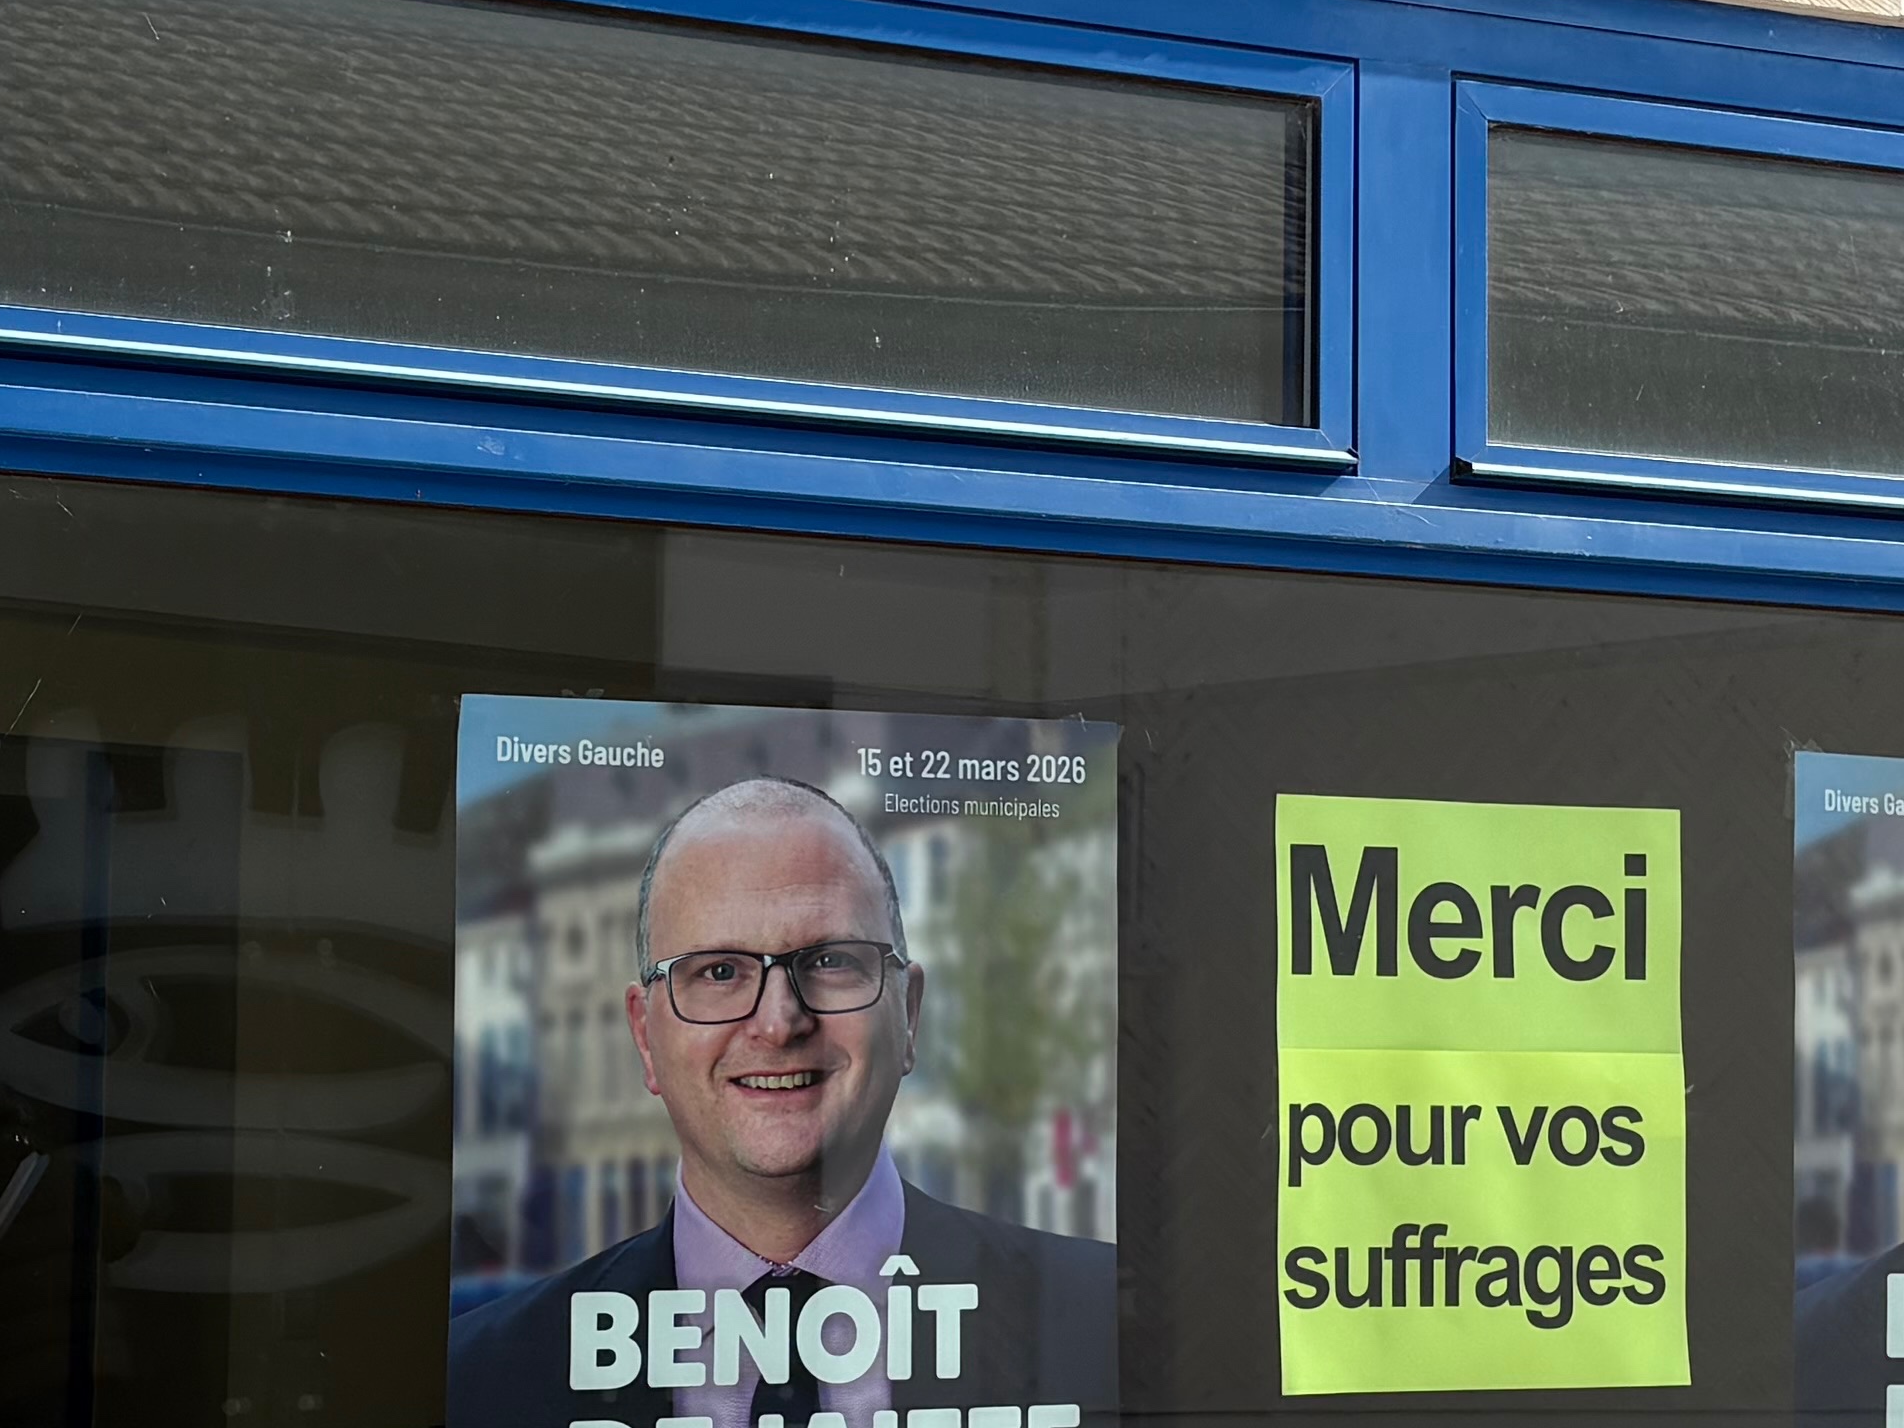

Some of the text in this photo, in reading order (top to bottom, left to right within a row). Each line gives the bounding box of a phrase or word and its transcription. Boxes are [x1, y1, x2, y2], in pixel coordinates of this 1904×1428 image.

[497, 736, 664, 768] Divers Gauche
[857, 748, 1086, 784] 15 et 22 mars 2026
[885, 793, 1060, 821] Elections municipales
[1825, 789, 1879, 814] Divers
[1290, 843, 1647, 982] Merci
[1287, 1102, 1646, 1188] pour vos
[1283, 1223, 1667, 1330] suffrages
[568, 1254, 979, 1391] BENOÎT
